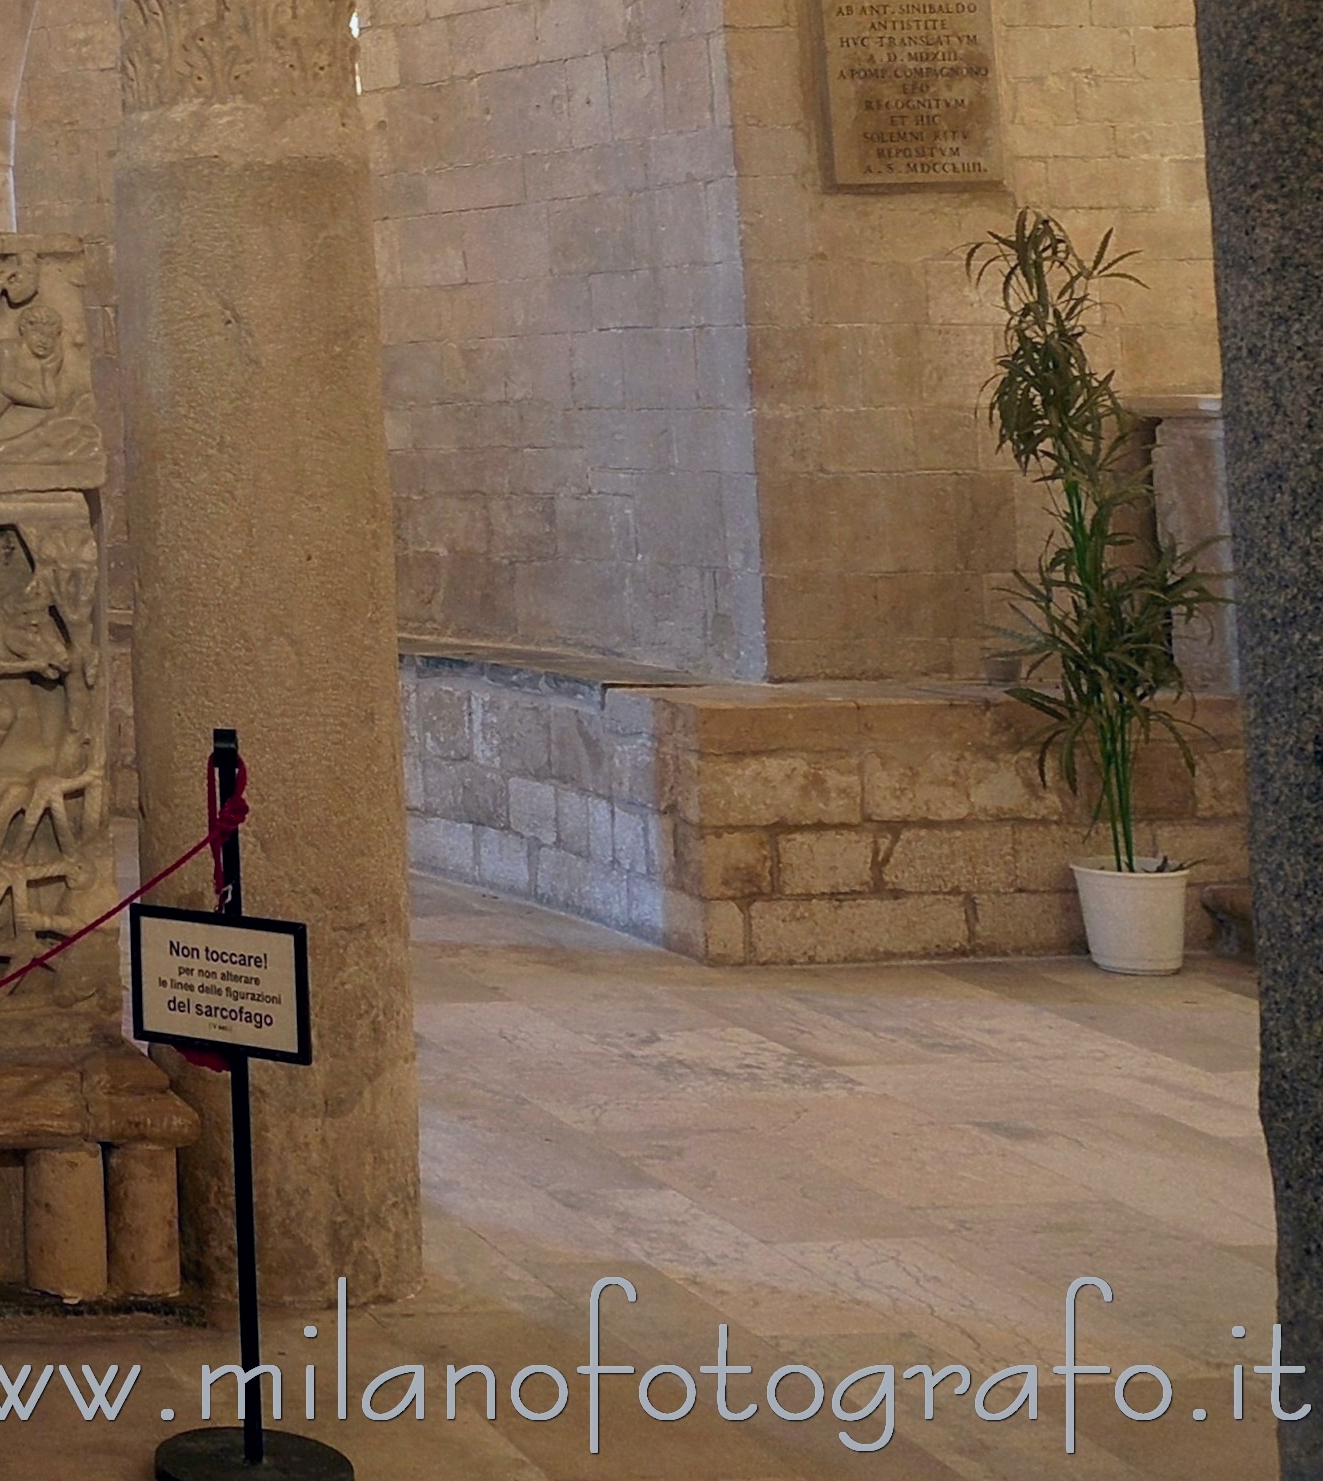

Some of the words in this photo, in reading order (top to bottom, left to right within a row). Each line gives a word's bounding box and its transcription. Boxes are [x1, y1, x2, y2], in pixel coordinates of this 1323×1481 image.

[836, 5, 854, 17] AB
[898, 2, 978, 15] SINIBALDO
[868, 19, 947, 31] ANTISTITE
[839, 35, 870, 48] HVC
[876, 34, 978, 48] TRANSLATVM
[864, 98, 965, 111] RECOGNITVM
[890, 115, 910, 127] ET
[914, 114, 942, 127] HIC
[862, 131, 925, 144] SOLEMNI
[876, 146, 961, 159] REPOSITVM
[169, 940, 200, 960] Non
[205, 946, 268, 970] toccare!
[178, 965, 195, 977] per
[198, 967, 218, 980] non
[220, 969, 261, 986] alterare
[158, 977, 168, 989] le
[170, 978, 195, 992] linee
[198, 982, 224, 997] delle
[225, 985, 282, 1005] figurazioni
[167, 996, 190, 1014] del
[195, 1003, 274, 1028] sarcofago
